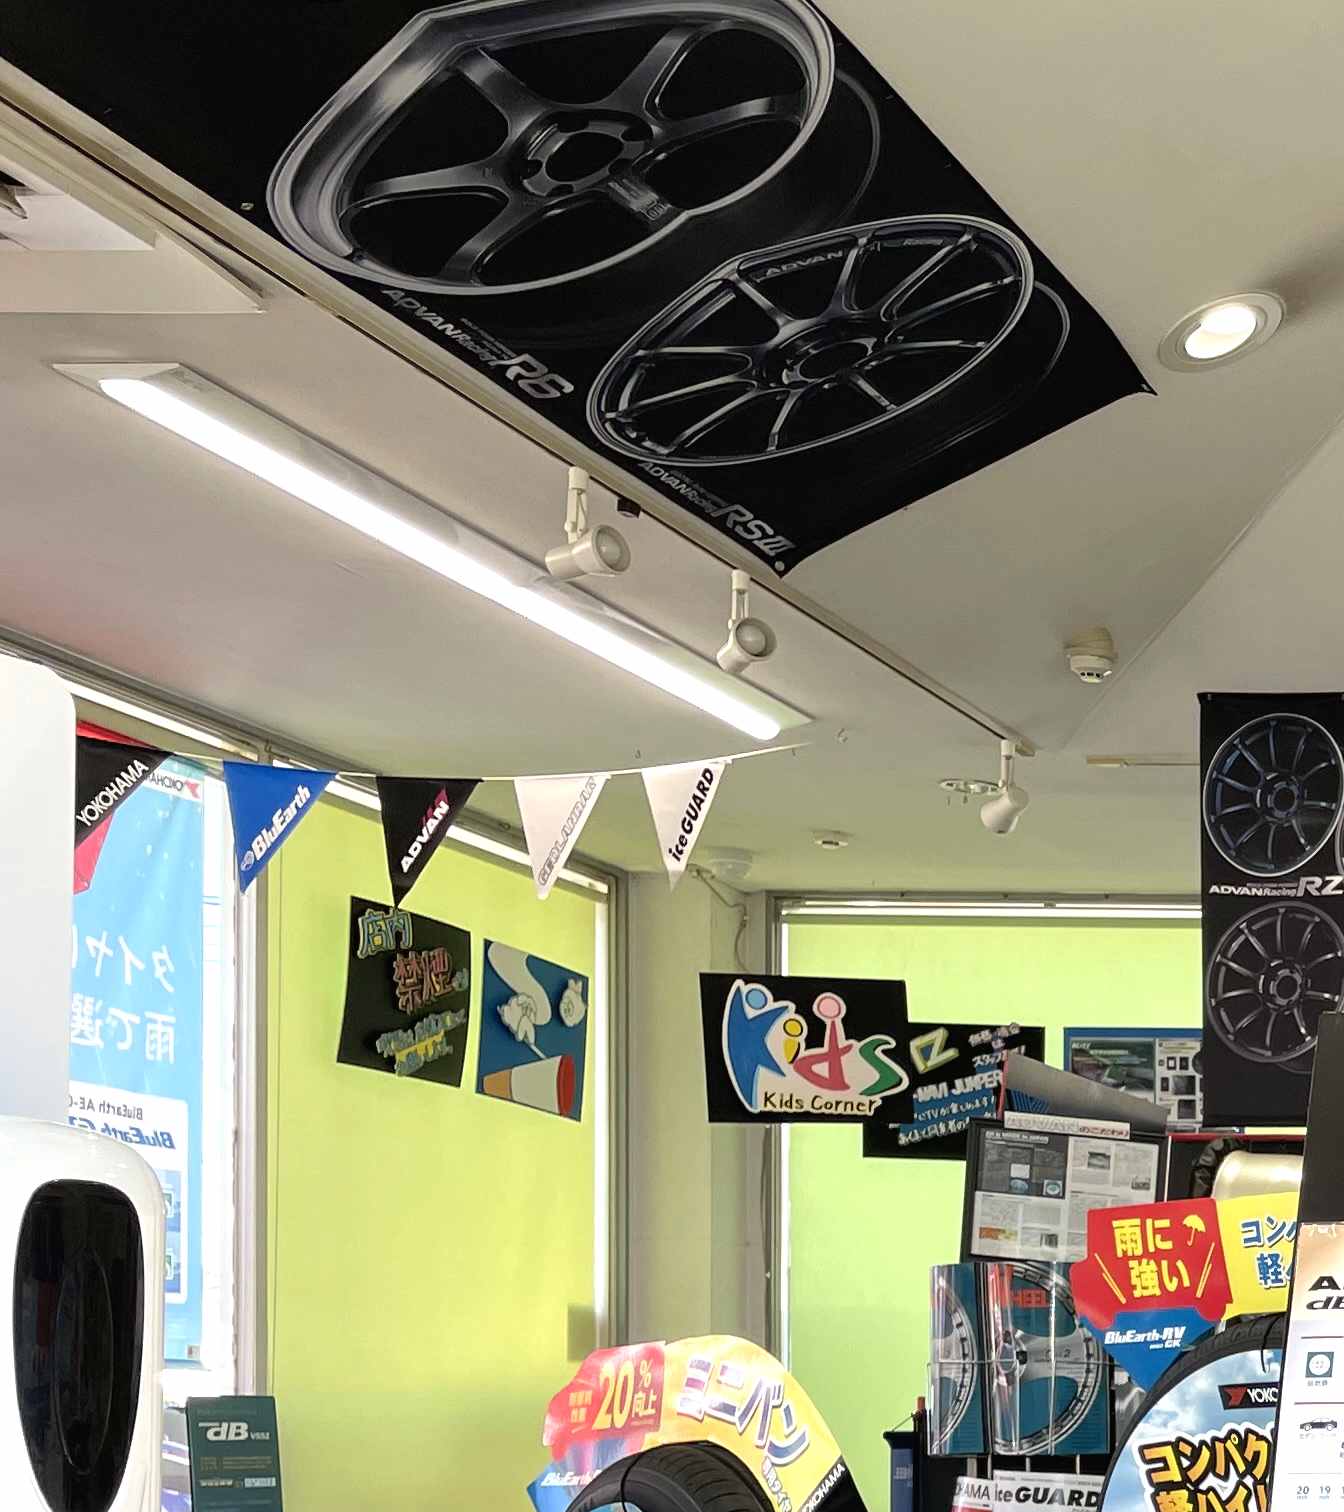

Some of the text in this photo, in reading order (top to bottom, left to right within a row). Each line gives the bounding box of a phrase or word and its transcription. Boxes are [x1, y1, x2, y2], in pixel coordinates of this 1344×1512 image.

[497, 352, 575, 399] R6
[76, 758, 149, 827] YOKOHAMA
[671, 766, 716, 864] iceGUARD
[251, 784, 312, 861] BluEarth
[401, 799, 451, 874] ADVAN
[763, 1092, 877, 1114] Kids Corner
[1113, 1217, 1173, 1259] 雨に
[1128, 1258, 1191, 1299] 強い
[1104, 1325, 1186, 1349] BluEarth-RV
[592, 1361, 635, 1431] 20
[205, 1420, 249, 1442] dB
